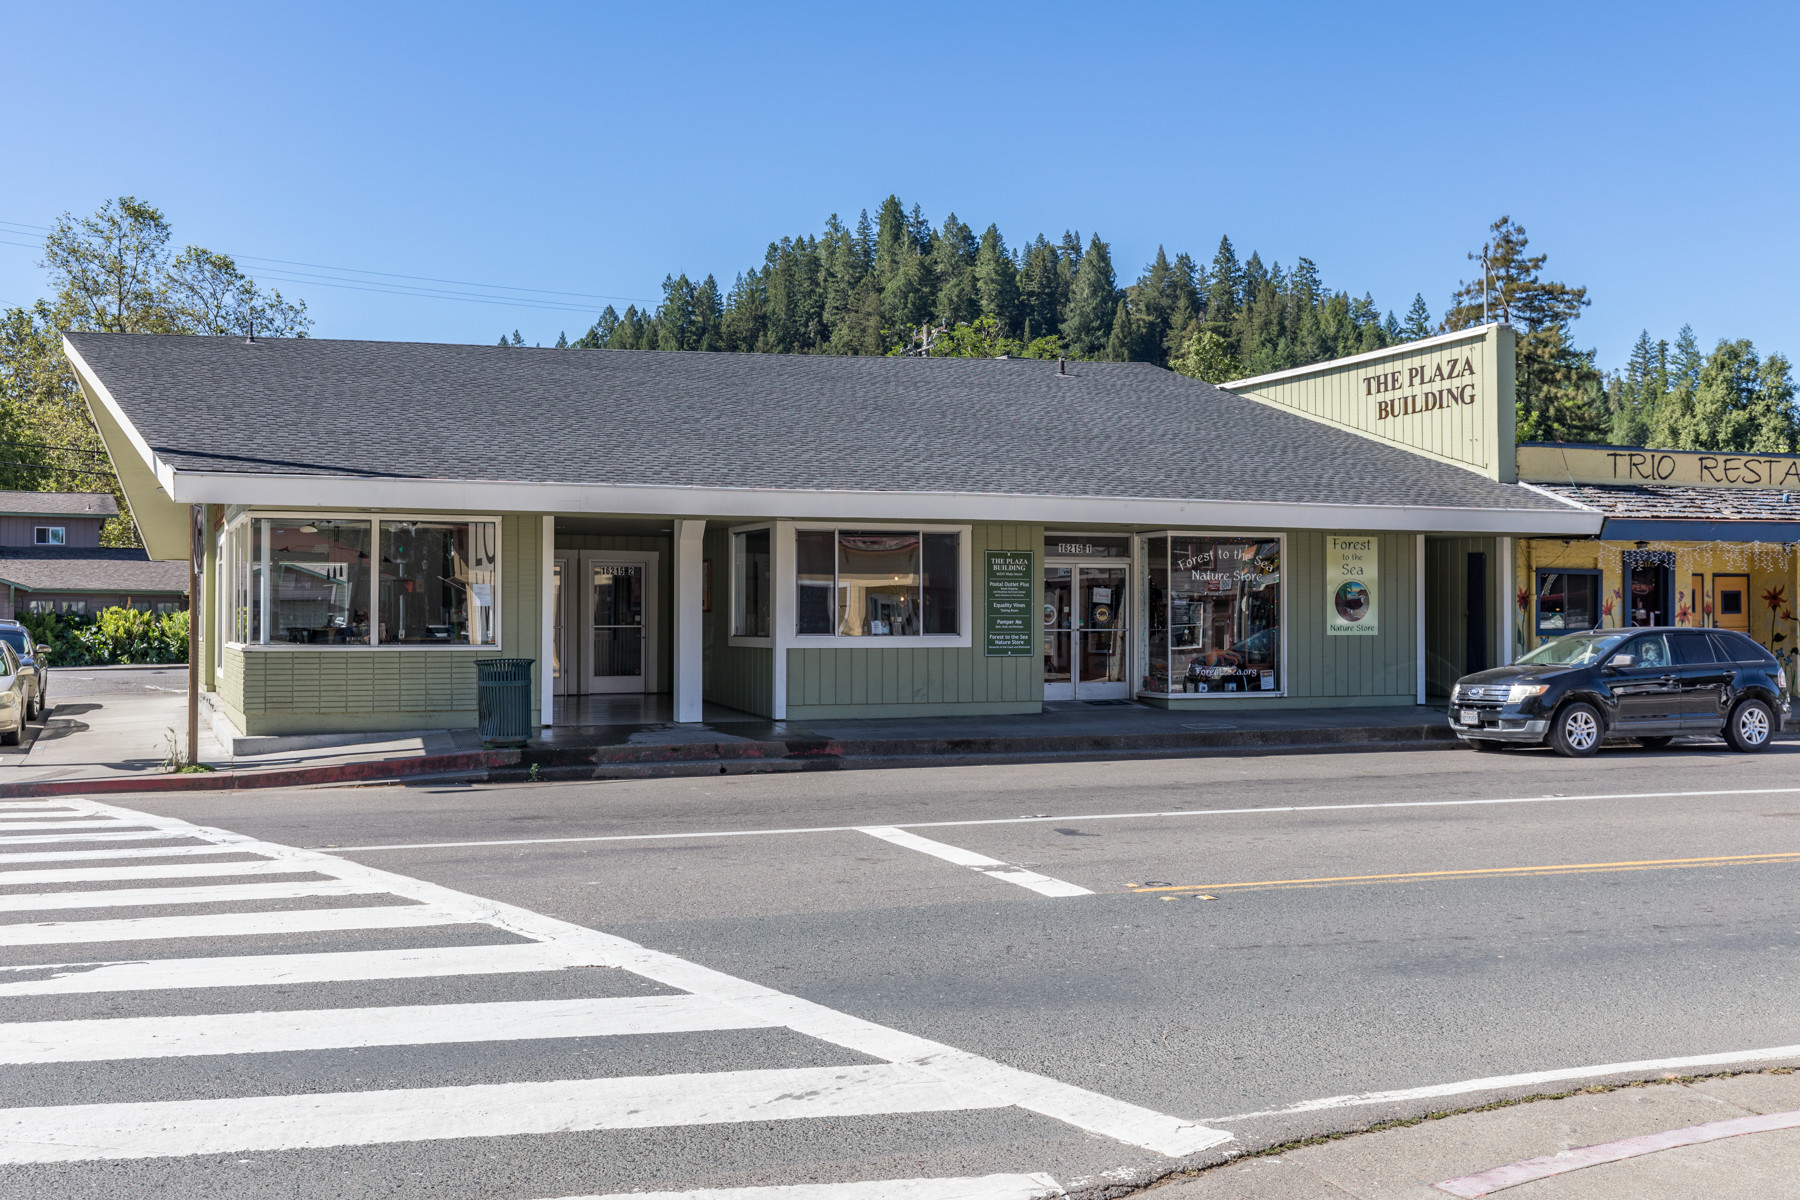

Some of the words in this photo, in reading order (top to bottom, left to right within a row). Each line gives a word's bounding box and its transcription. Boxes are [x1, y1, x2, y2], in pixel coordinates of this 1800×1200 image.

[1363, 370, 1402, 396] THE
[1408, 356, 1476, 388] PLAZA
[1377, 383, 1476, 420] BUILDING
[1607, 453, 1676, 480] TRIO
[1698, 456, 1800, 486] RESTA
[1333, 538, 1371, 550] Forest
[1178, 550, 1214, 571] Forest
[1217, 549, 1230, 559] to
[1233, 549, 1251, 562] the
[1254, 555, 1273, 573] Sea
[1342, 553, 1350, 561] to
[1352, 553, 1363, 561] the
[1191, 570, 1229, 580] Nature
[1233, 570, 1263, 581] Store
[1342, 563, 1364, 575] Sea
